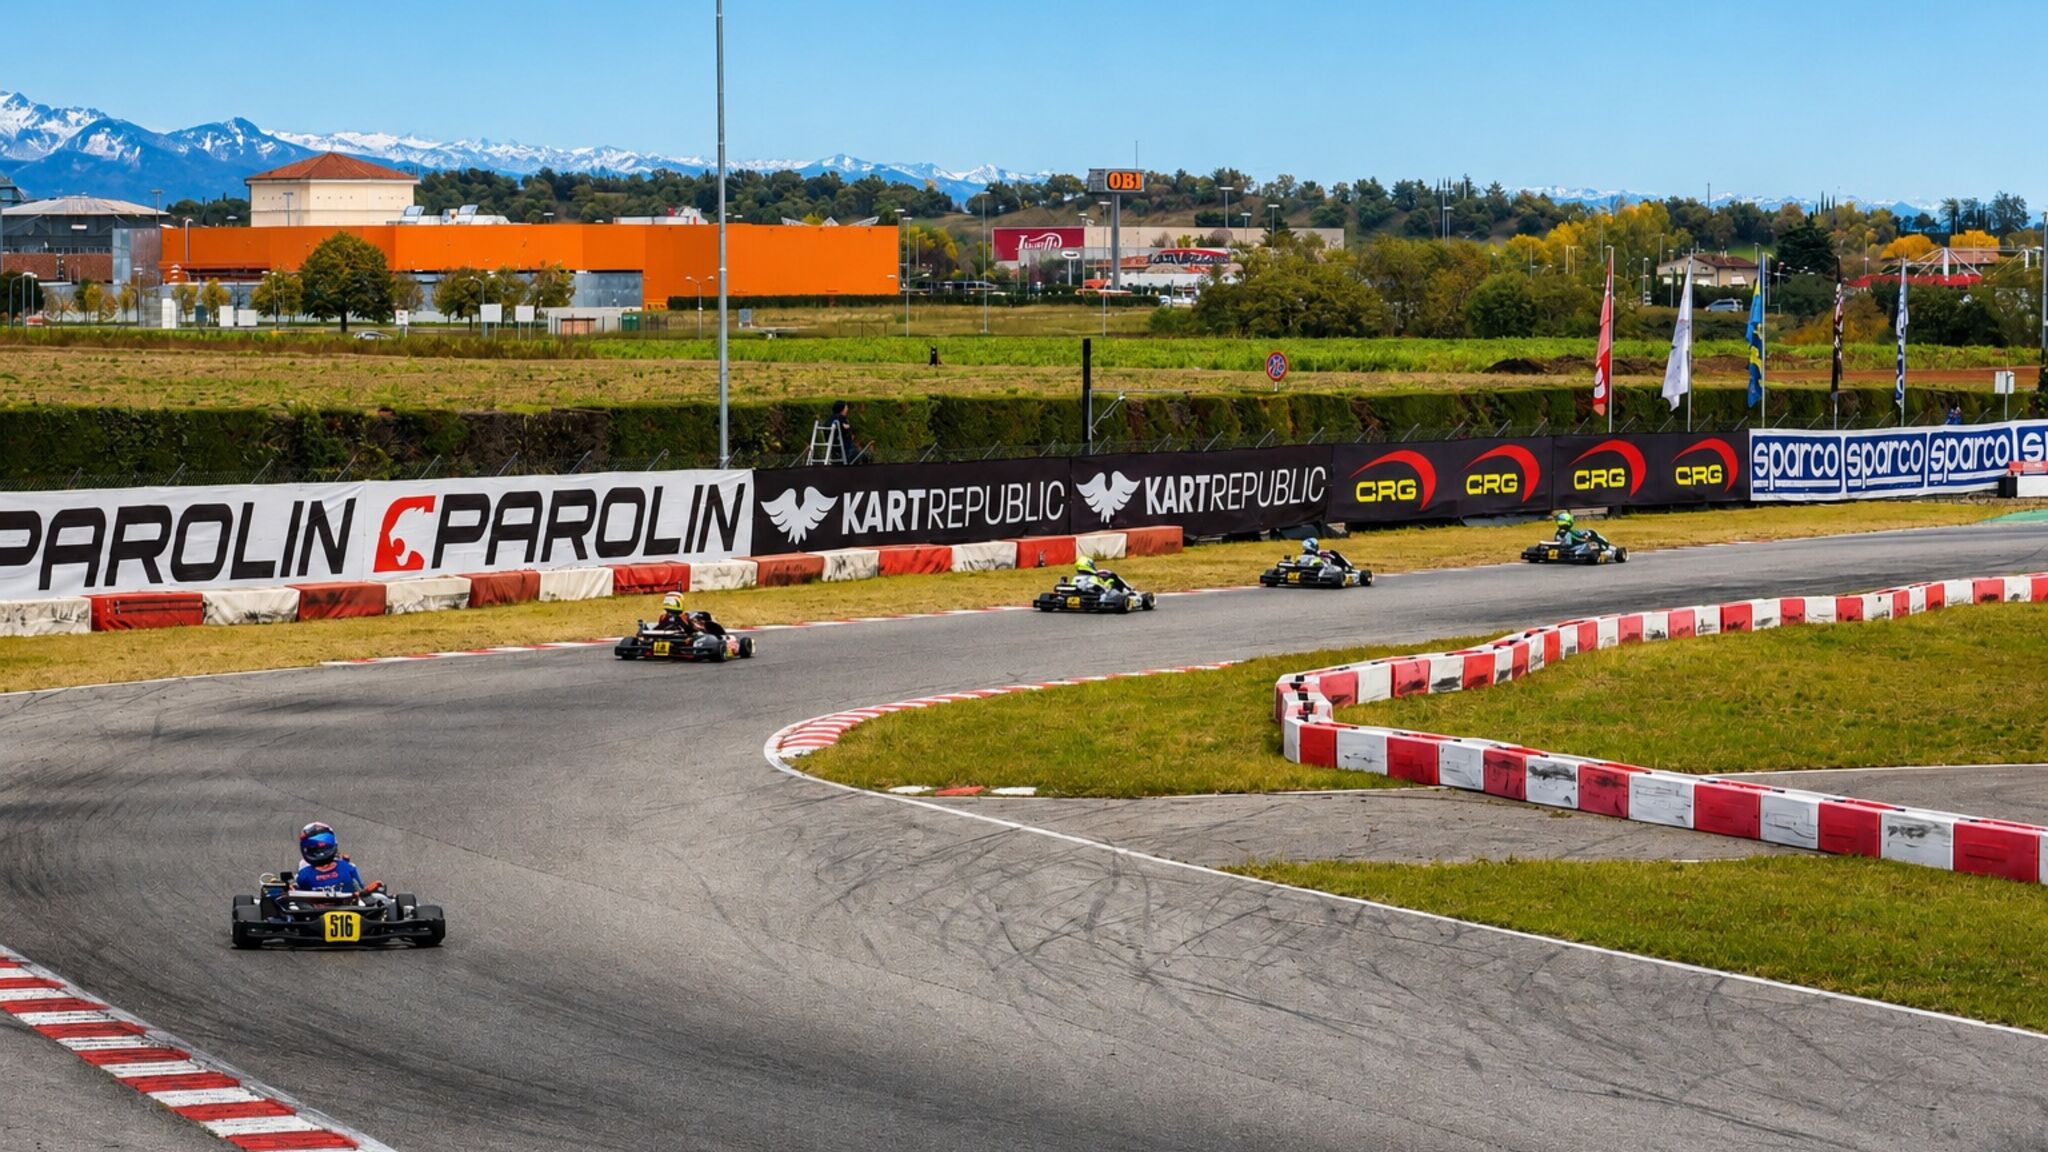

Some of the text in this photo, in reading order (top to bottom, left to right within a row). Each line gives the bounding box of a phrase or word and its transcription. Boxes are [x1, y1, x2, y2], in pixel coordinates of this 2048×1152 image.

[1753, 441, 1840, 490] sparco
[1846, 439, 1924, 488] sparco
[1930, 434, 2010, 483] sparco
[1466, 473, 1518, 495] CRG
[1573, 467, 1626, 490] CRG
[1675, 464, 1723, 486] CRG
[1355, 479, 1417, 503] CRG
[431, 482, 746, 570] PAROLIN
[330, 914, 353, 938] 516
